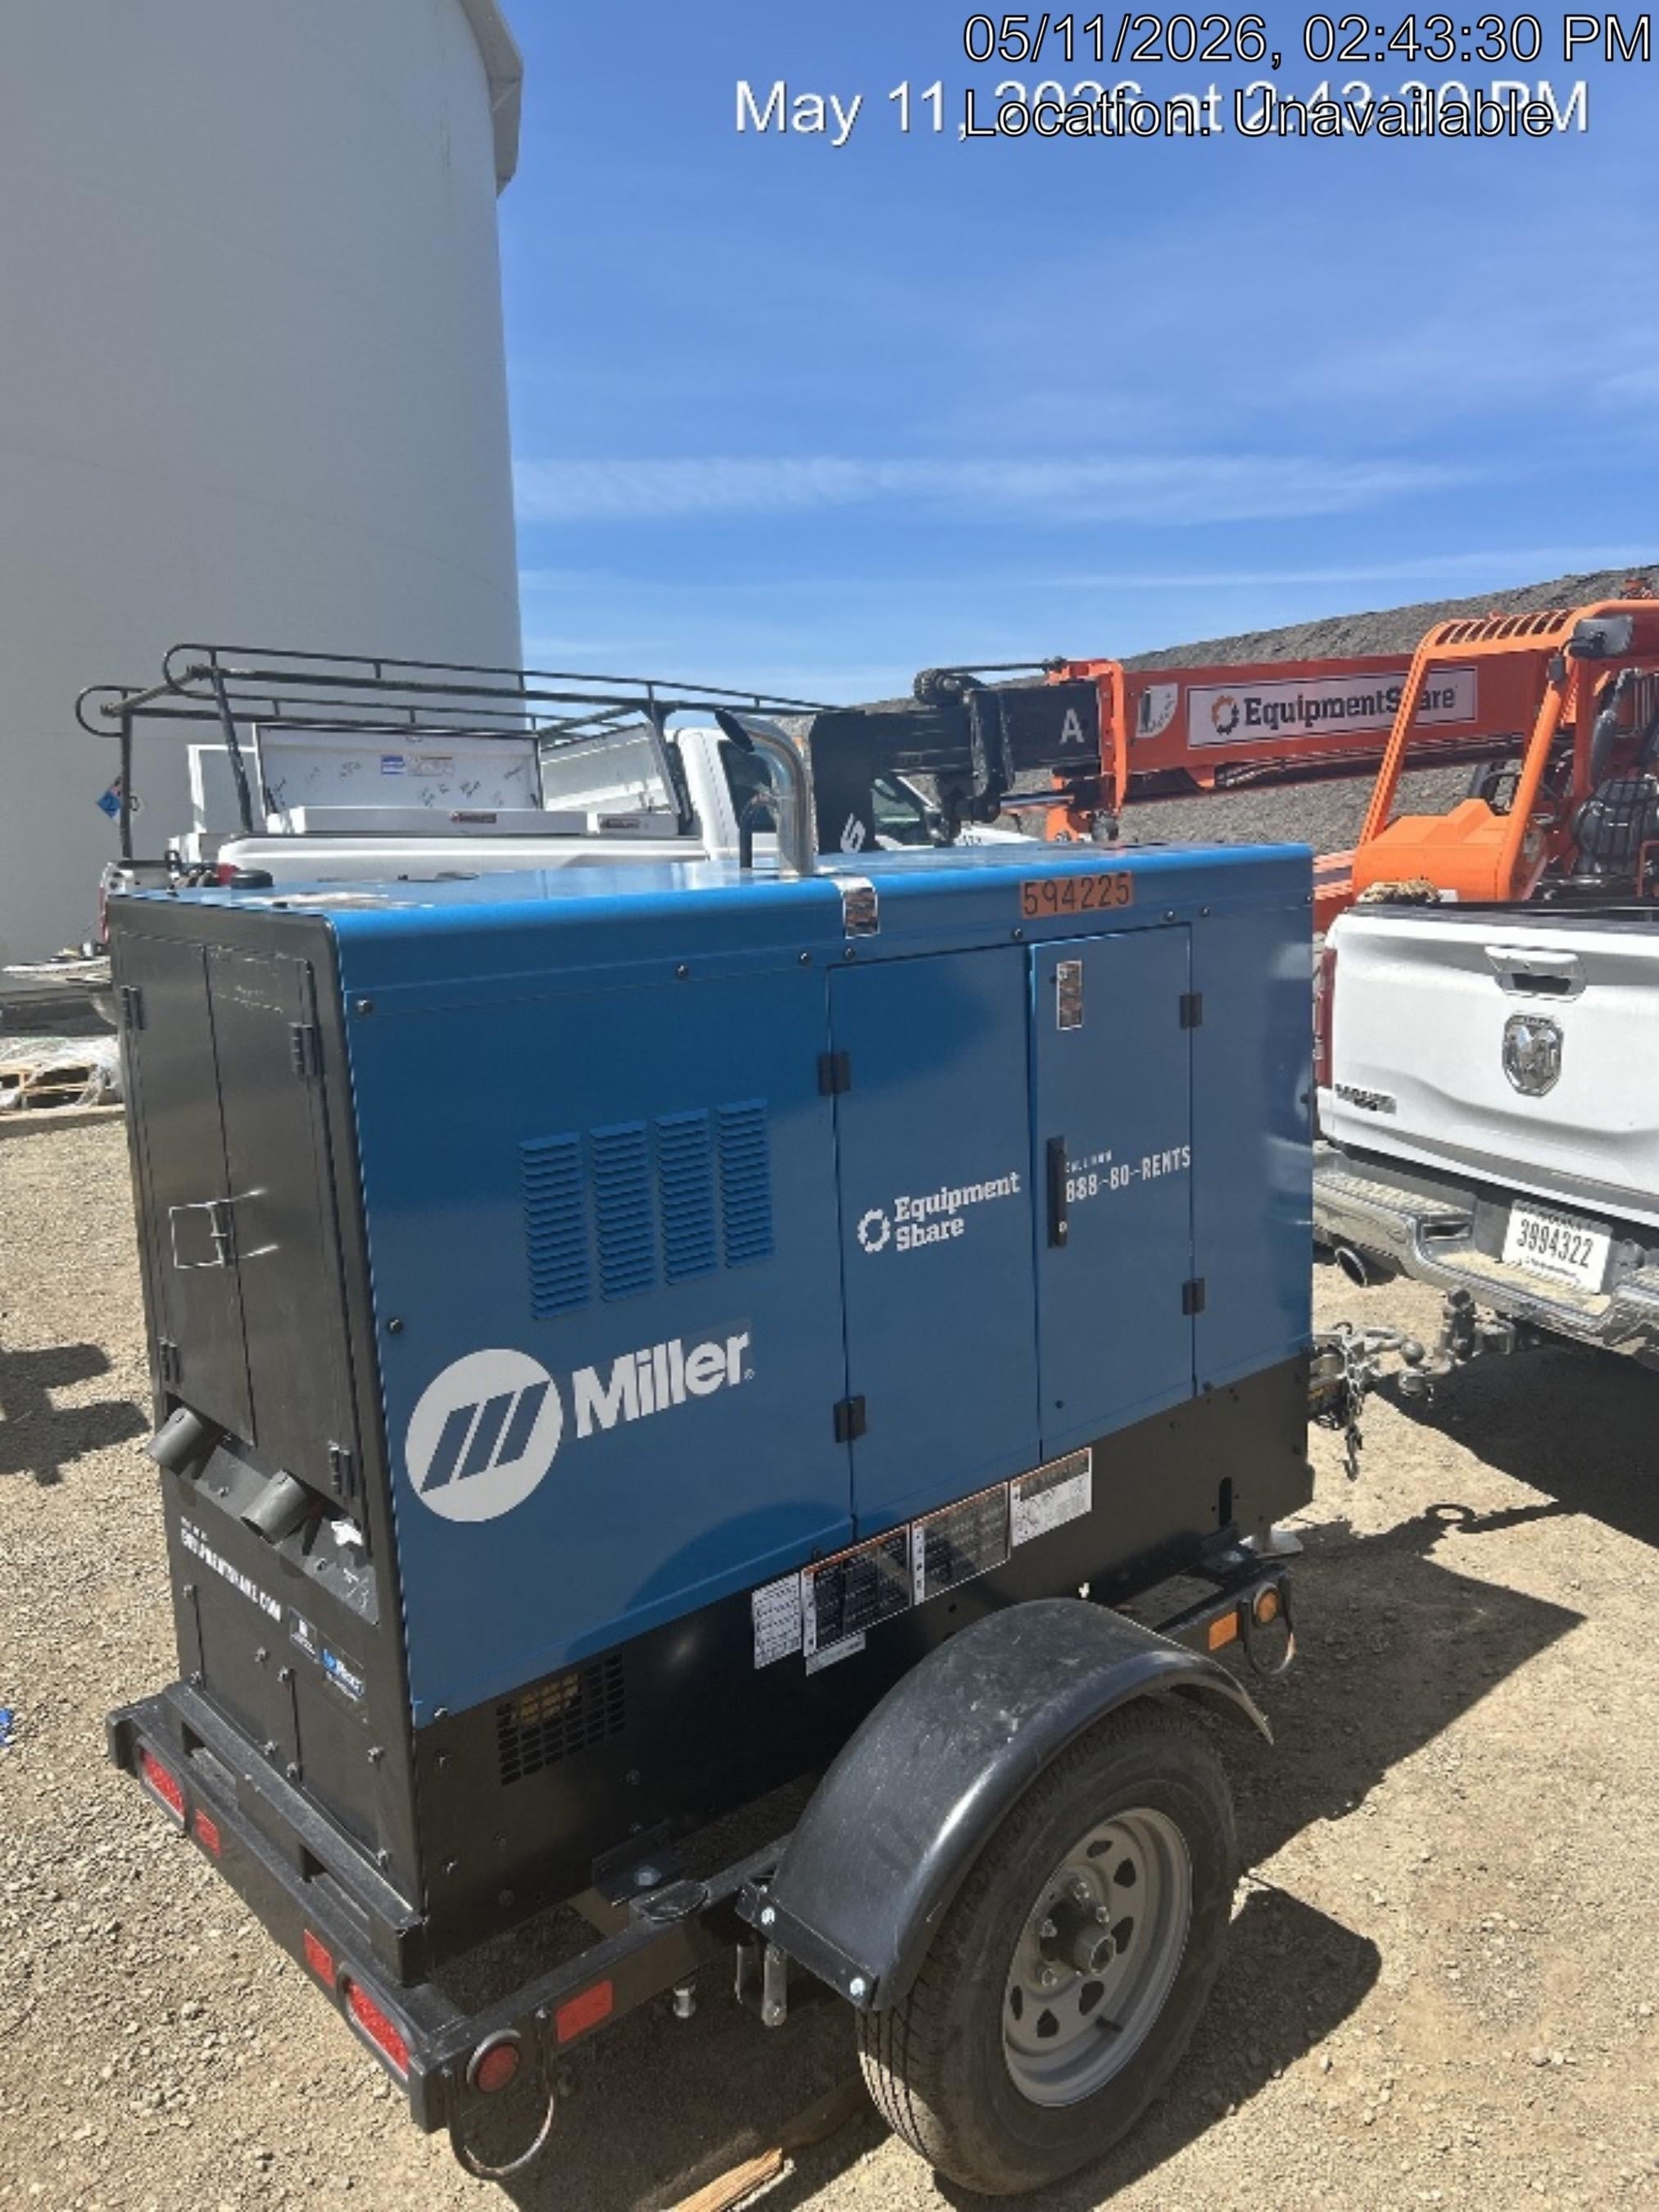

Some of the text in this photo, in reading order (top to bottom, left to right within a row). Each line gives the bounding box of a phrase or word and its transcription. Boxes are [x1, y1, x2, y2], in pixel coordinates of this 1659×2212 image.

[1059, 707, 1085, 745] A
[1243, 687, 1455, 730] EquipmentSare
[1023, 872, 1129, 916] 594225
[894, 1172, 1021, 1222] Equipment
[1066, 1145, 1190, 1203] 888-80-RENTS
[896, 1217, 965, 1252] Share
[1516, 1219, 1593, 1268] 3994322
[572, 1331, 750, 1439] Miller
